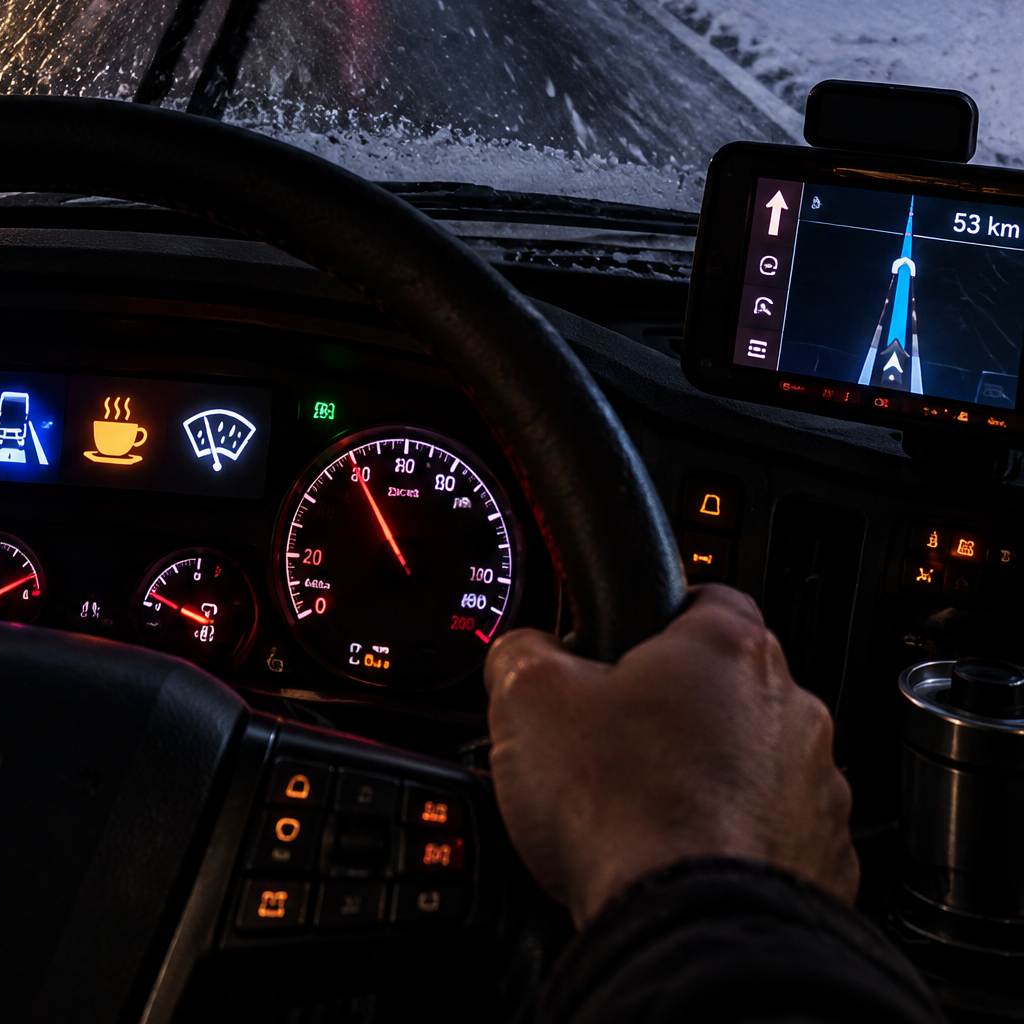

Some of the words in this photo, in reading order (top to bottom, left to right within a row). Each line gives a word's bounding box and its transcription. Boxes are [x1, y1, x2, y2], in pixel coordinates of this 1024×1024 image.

[953, 212, 981, 234] 53
[987, 215, 1020, 239] km
[302, 548, 322, 566] 20
[314, 597, 327, 614] 0
